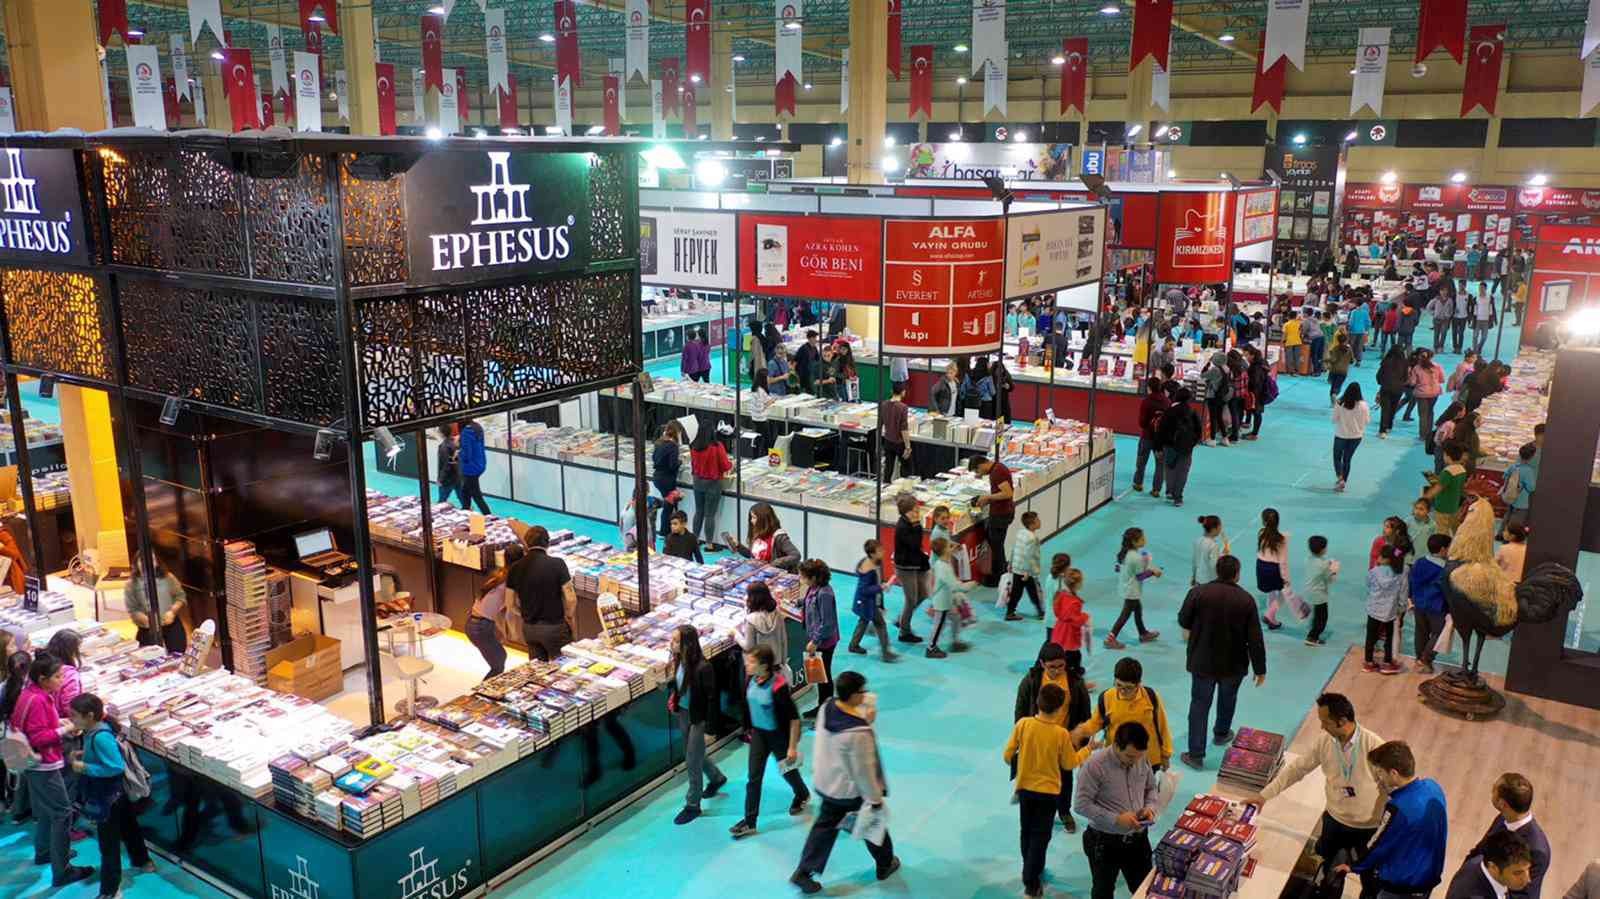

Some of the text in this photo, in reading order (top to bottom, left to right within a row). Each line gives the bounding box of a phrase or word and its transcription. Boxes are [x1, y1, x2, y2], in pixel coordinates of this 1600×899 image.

[928, 225, 977, 239] ALFA
[428, 224, 570, 272] EPHESUS
[911, 240, 989, 250] YAYIN GRUBU
[673, 237, 718, 275] HEPYEK
[800, 254, 829, 270] GÖR
[902, 328, 929, 343] kapı
